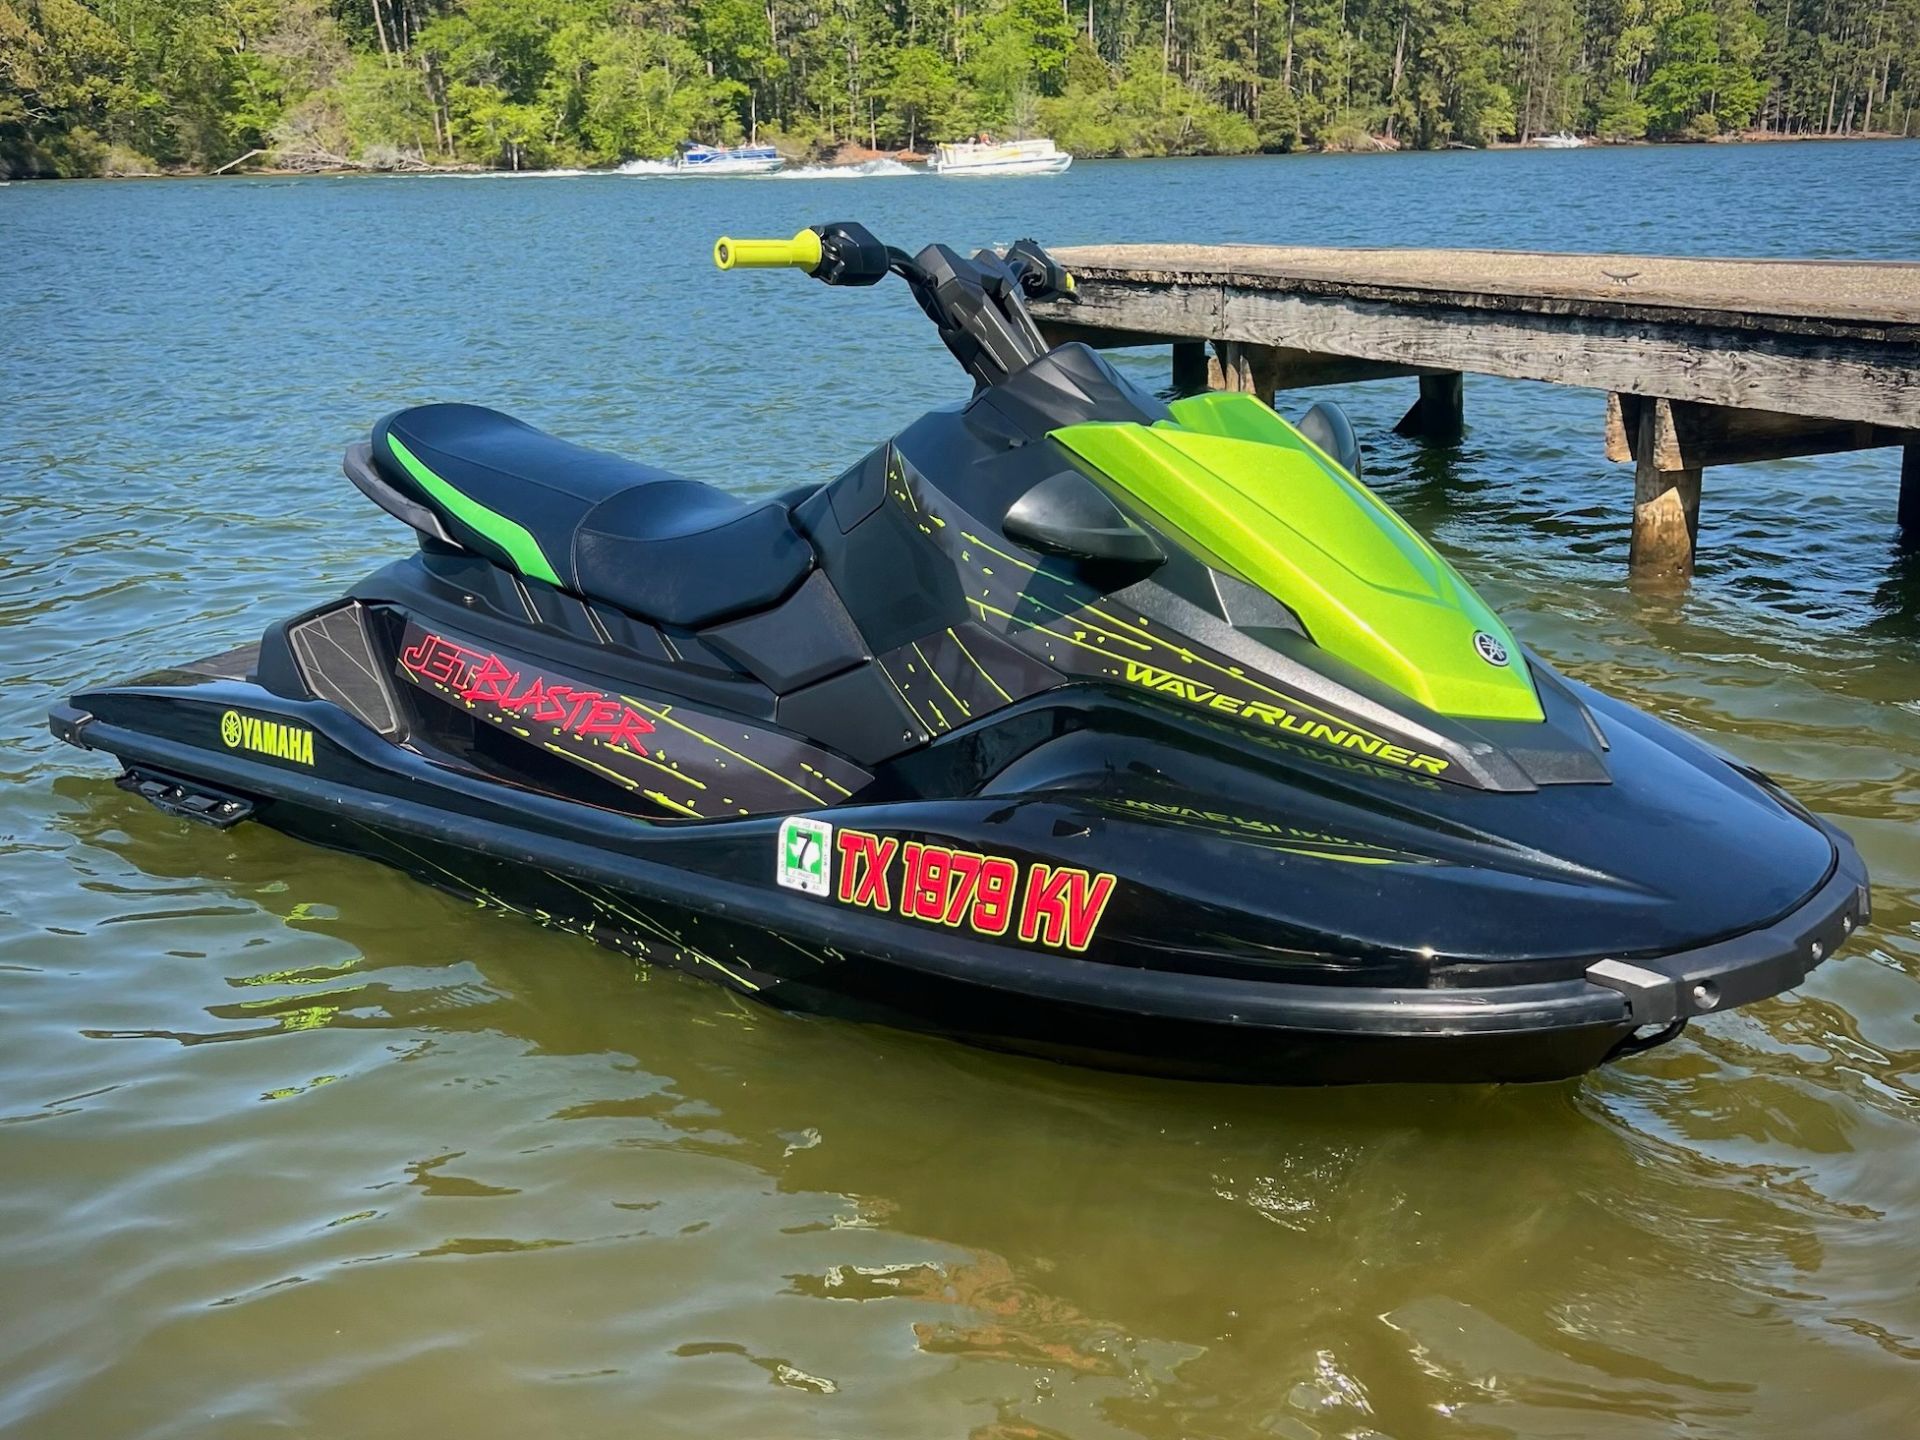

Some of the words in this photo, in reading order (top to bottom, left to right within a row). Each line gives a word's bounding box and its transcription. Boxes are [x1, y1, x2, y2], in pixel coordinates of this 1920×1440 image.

[241, 716, 315, 766] YAMAHA
[1125, 662, 1450, 775] WAVERUNNER
[796, 831, 813, 869] 7
[838, 828, 899, 911] TX
[901, 843, 1018, 935] 1979
[1018, 863, 1117, 951] KV
